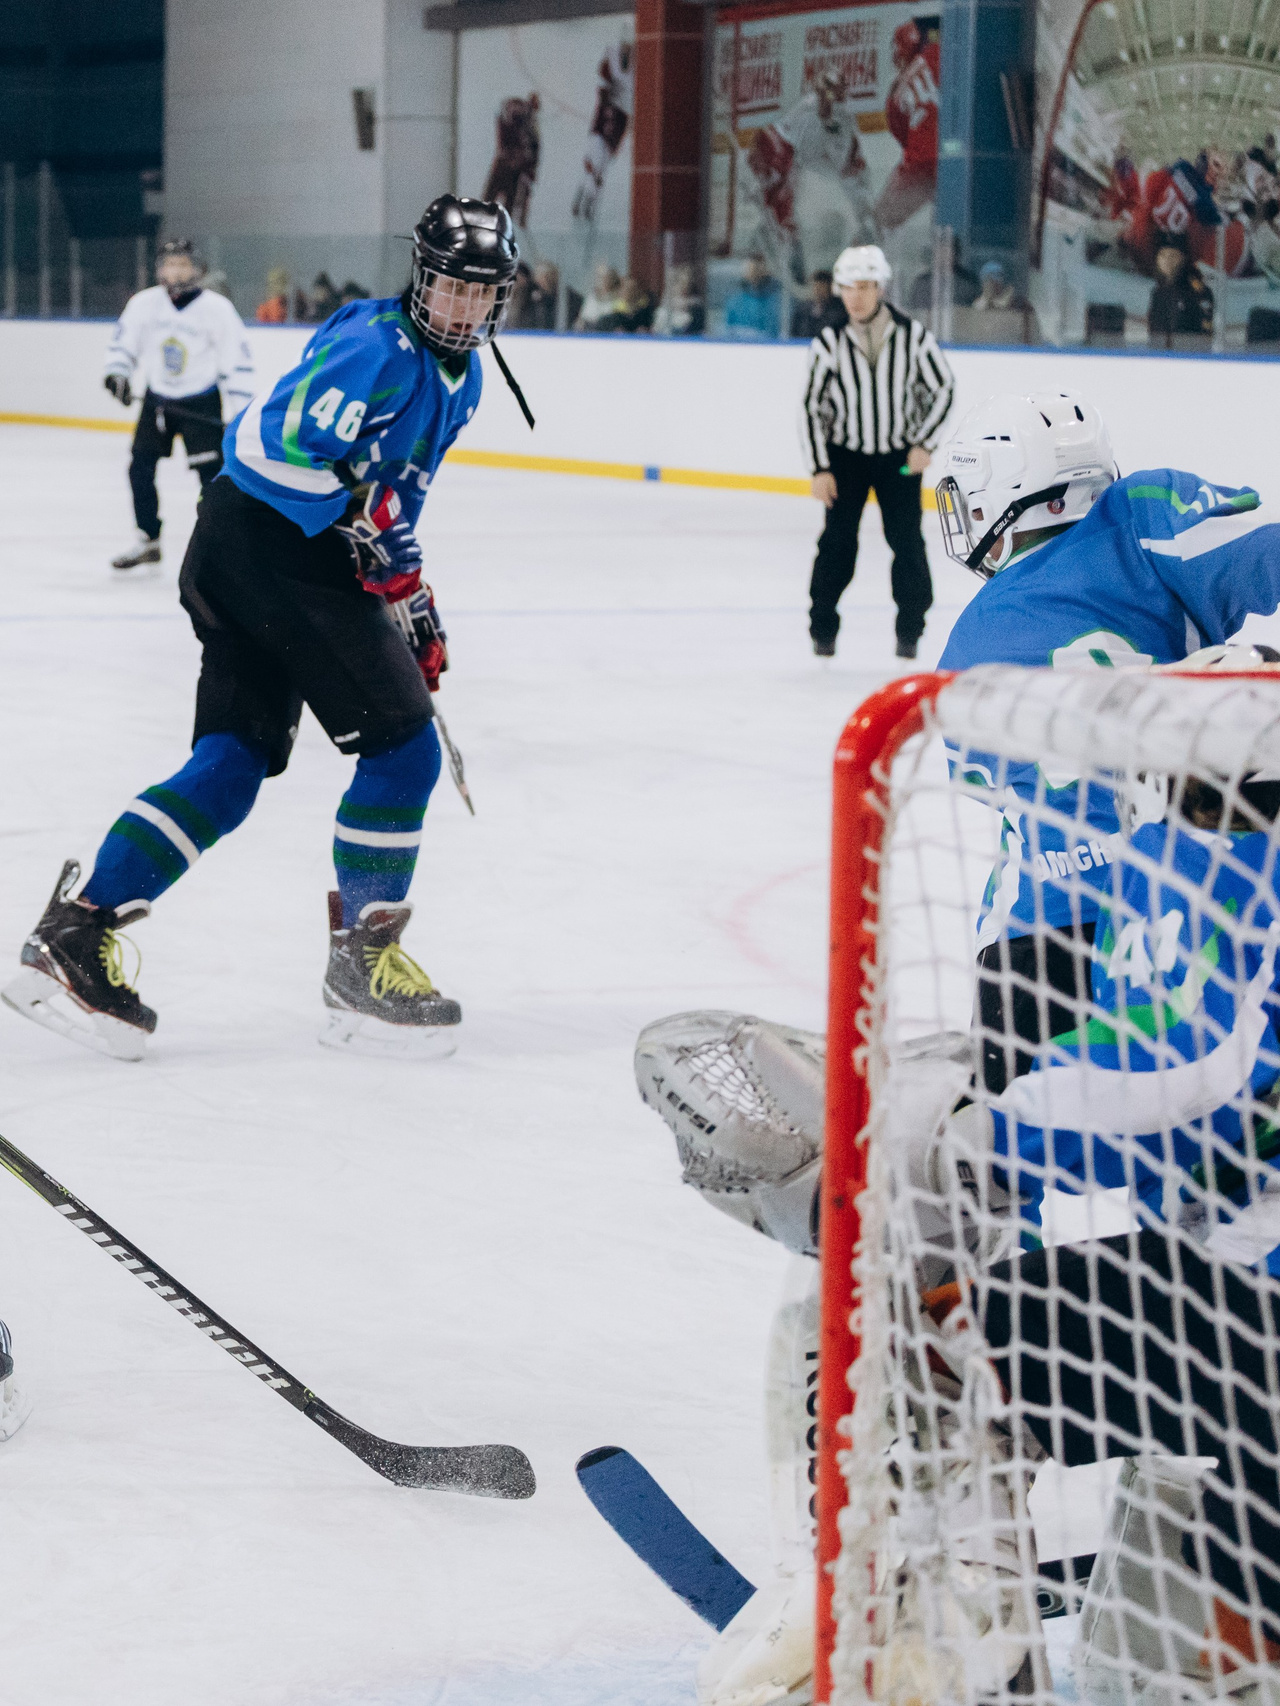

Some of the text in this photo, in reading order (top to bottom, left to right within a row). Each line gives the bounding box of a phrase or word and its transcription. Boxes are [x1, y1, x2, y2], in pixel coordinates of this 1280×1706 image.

[308, 386, 367, 443] 46
[993, 510, 1015, 536] BAUR
[666, 1090, 717, 1135] EFSI
